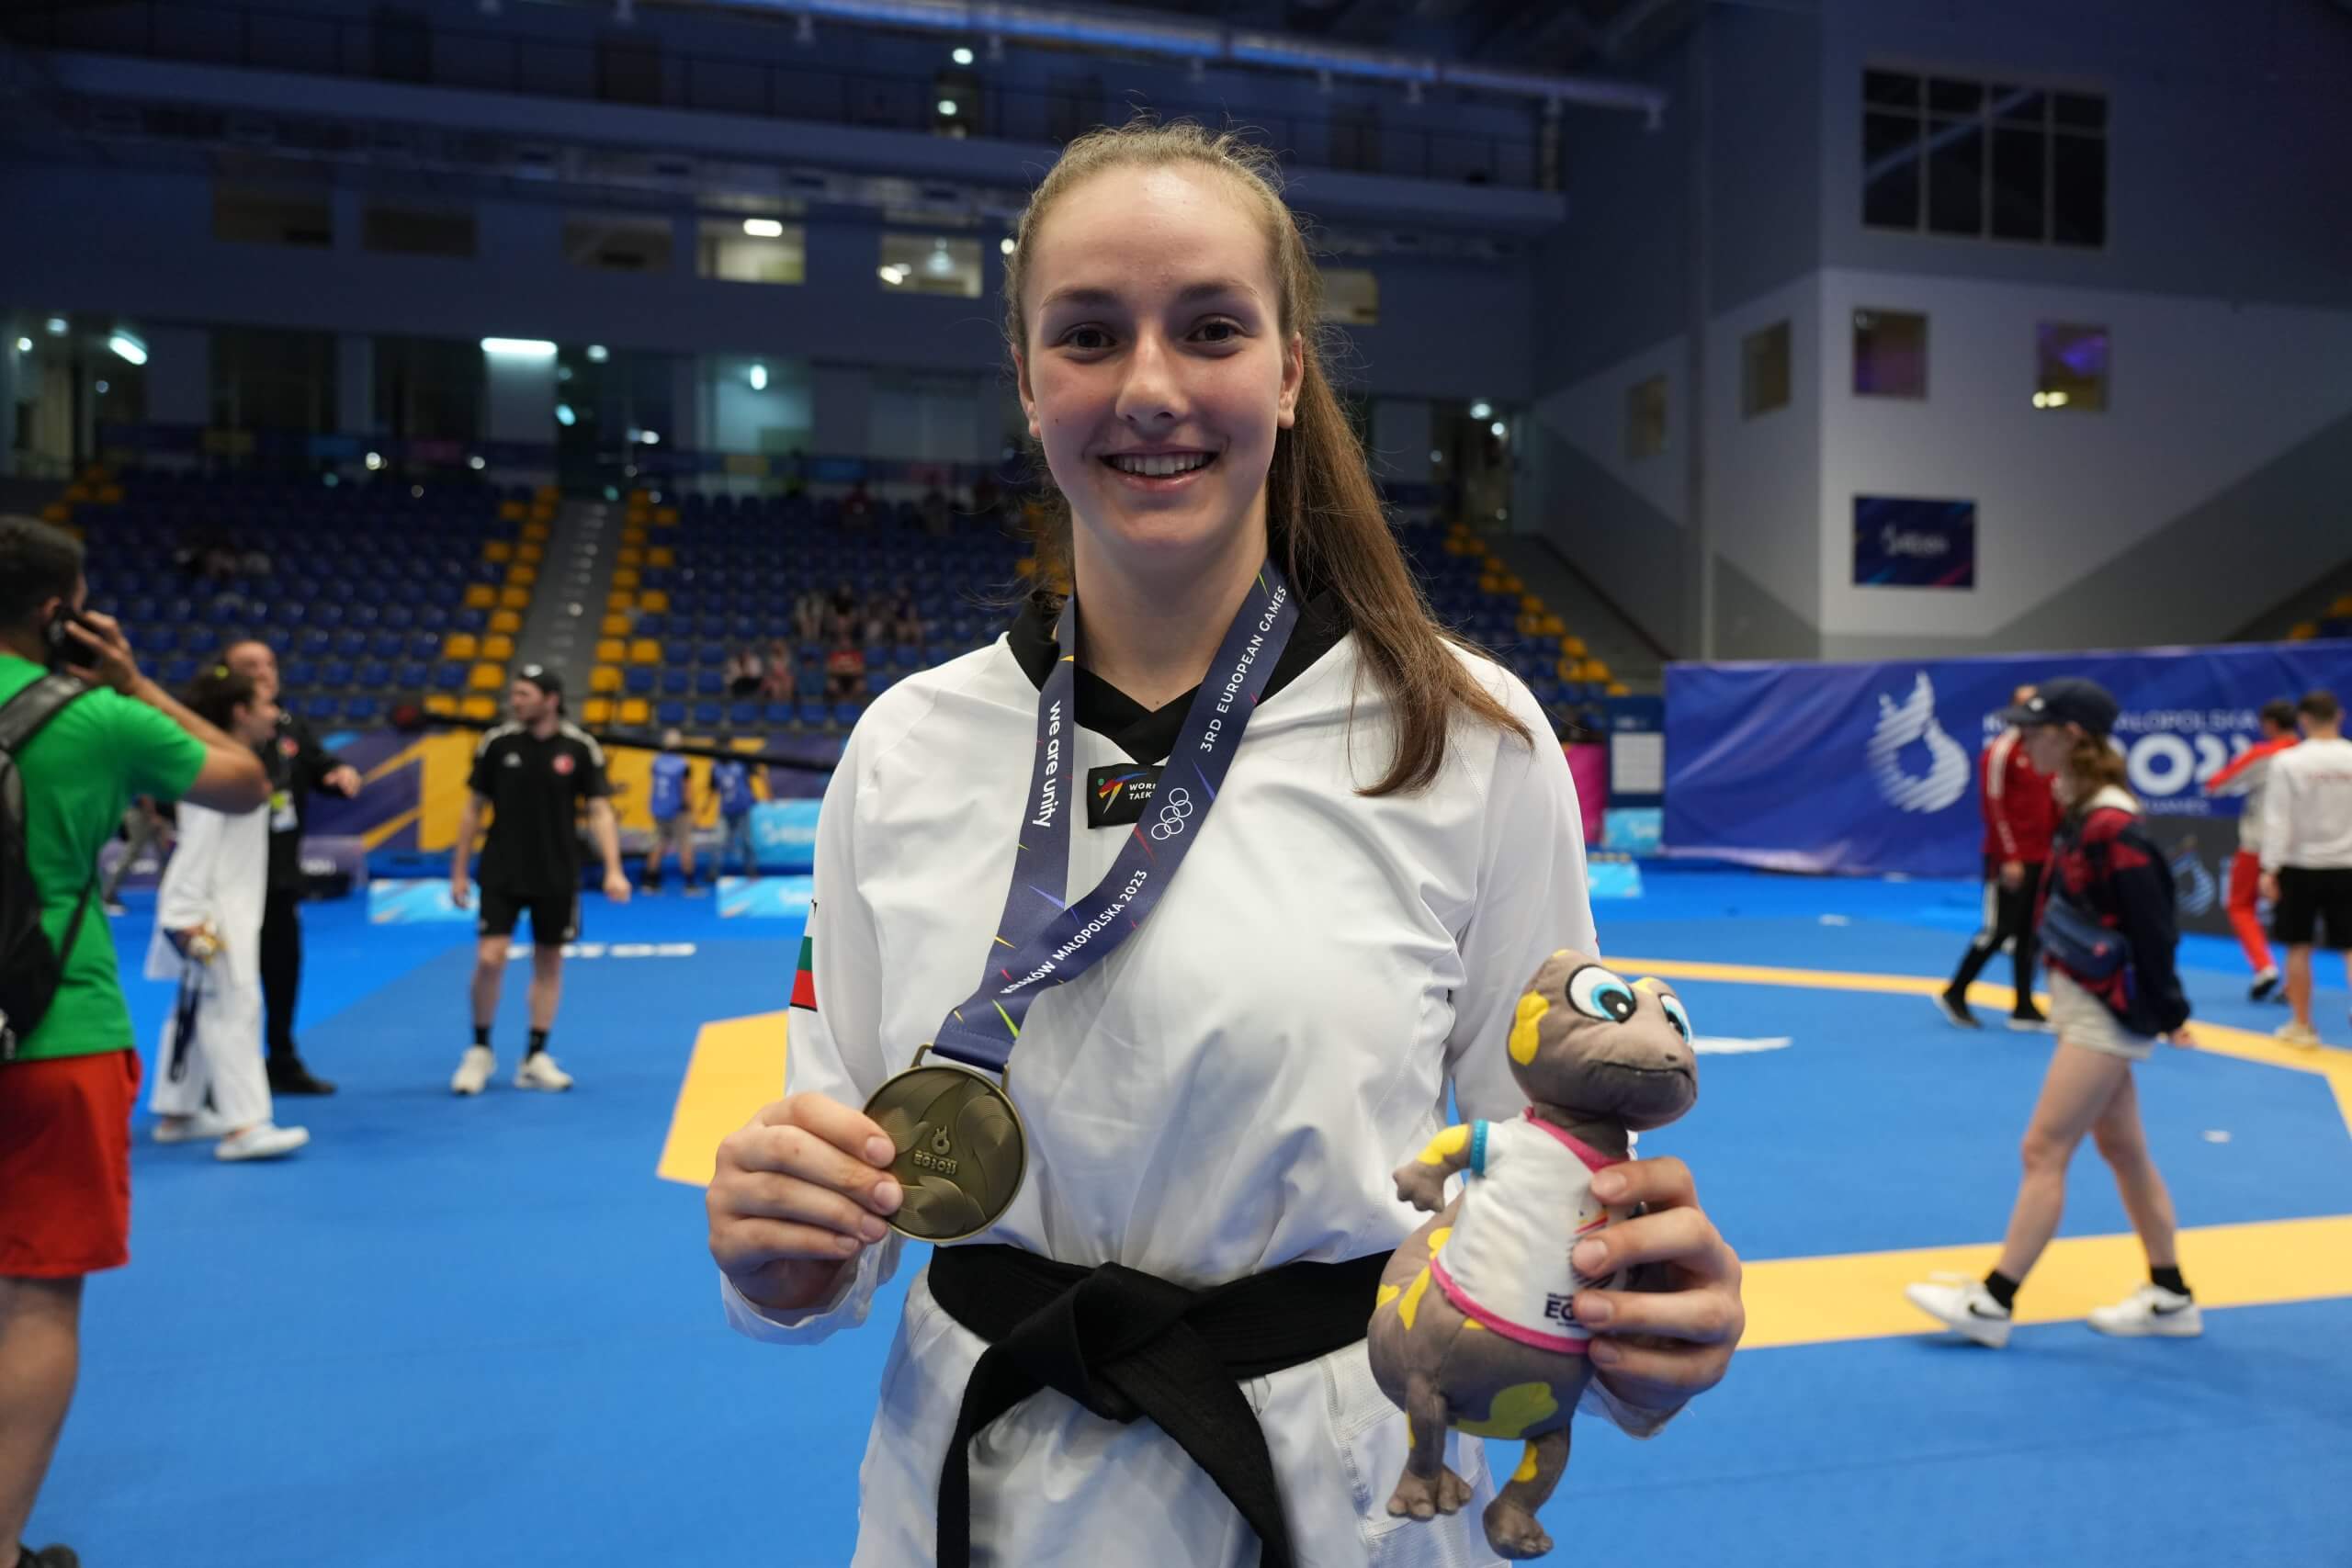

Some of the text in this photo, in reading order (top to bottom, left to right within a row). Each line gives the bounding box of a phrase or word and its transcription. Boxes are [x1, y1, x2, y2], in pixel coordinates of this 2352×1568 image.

[1200, 585, 1287, 752] 3RD EUROPEAN GAMES
[1032, 699, 1061, 828] we are unity
[1052, 903, 1125, 961] MAŁOPOLSKA
[1119, 870, 1148, 902] 2023
